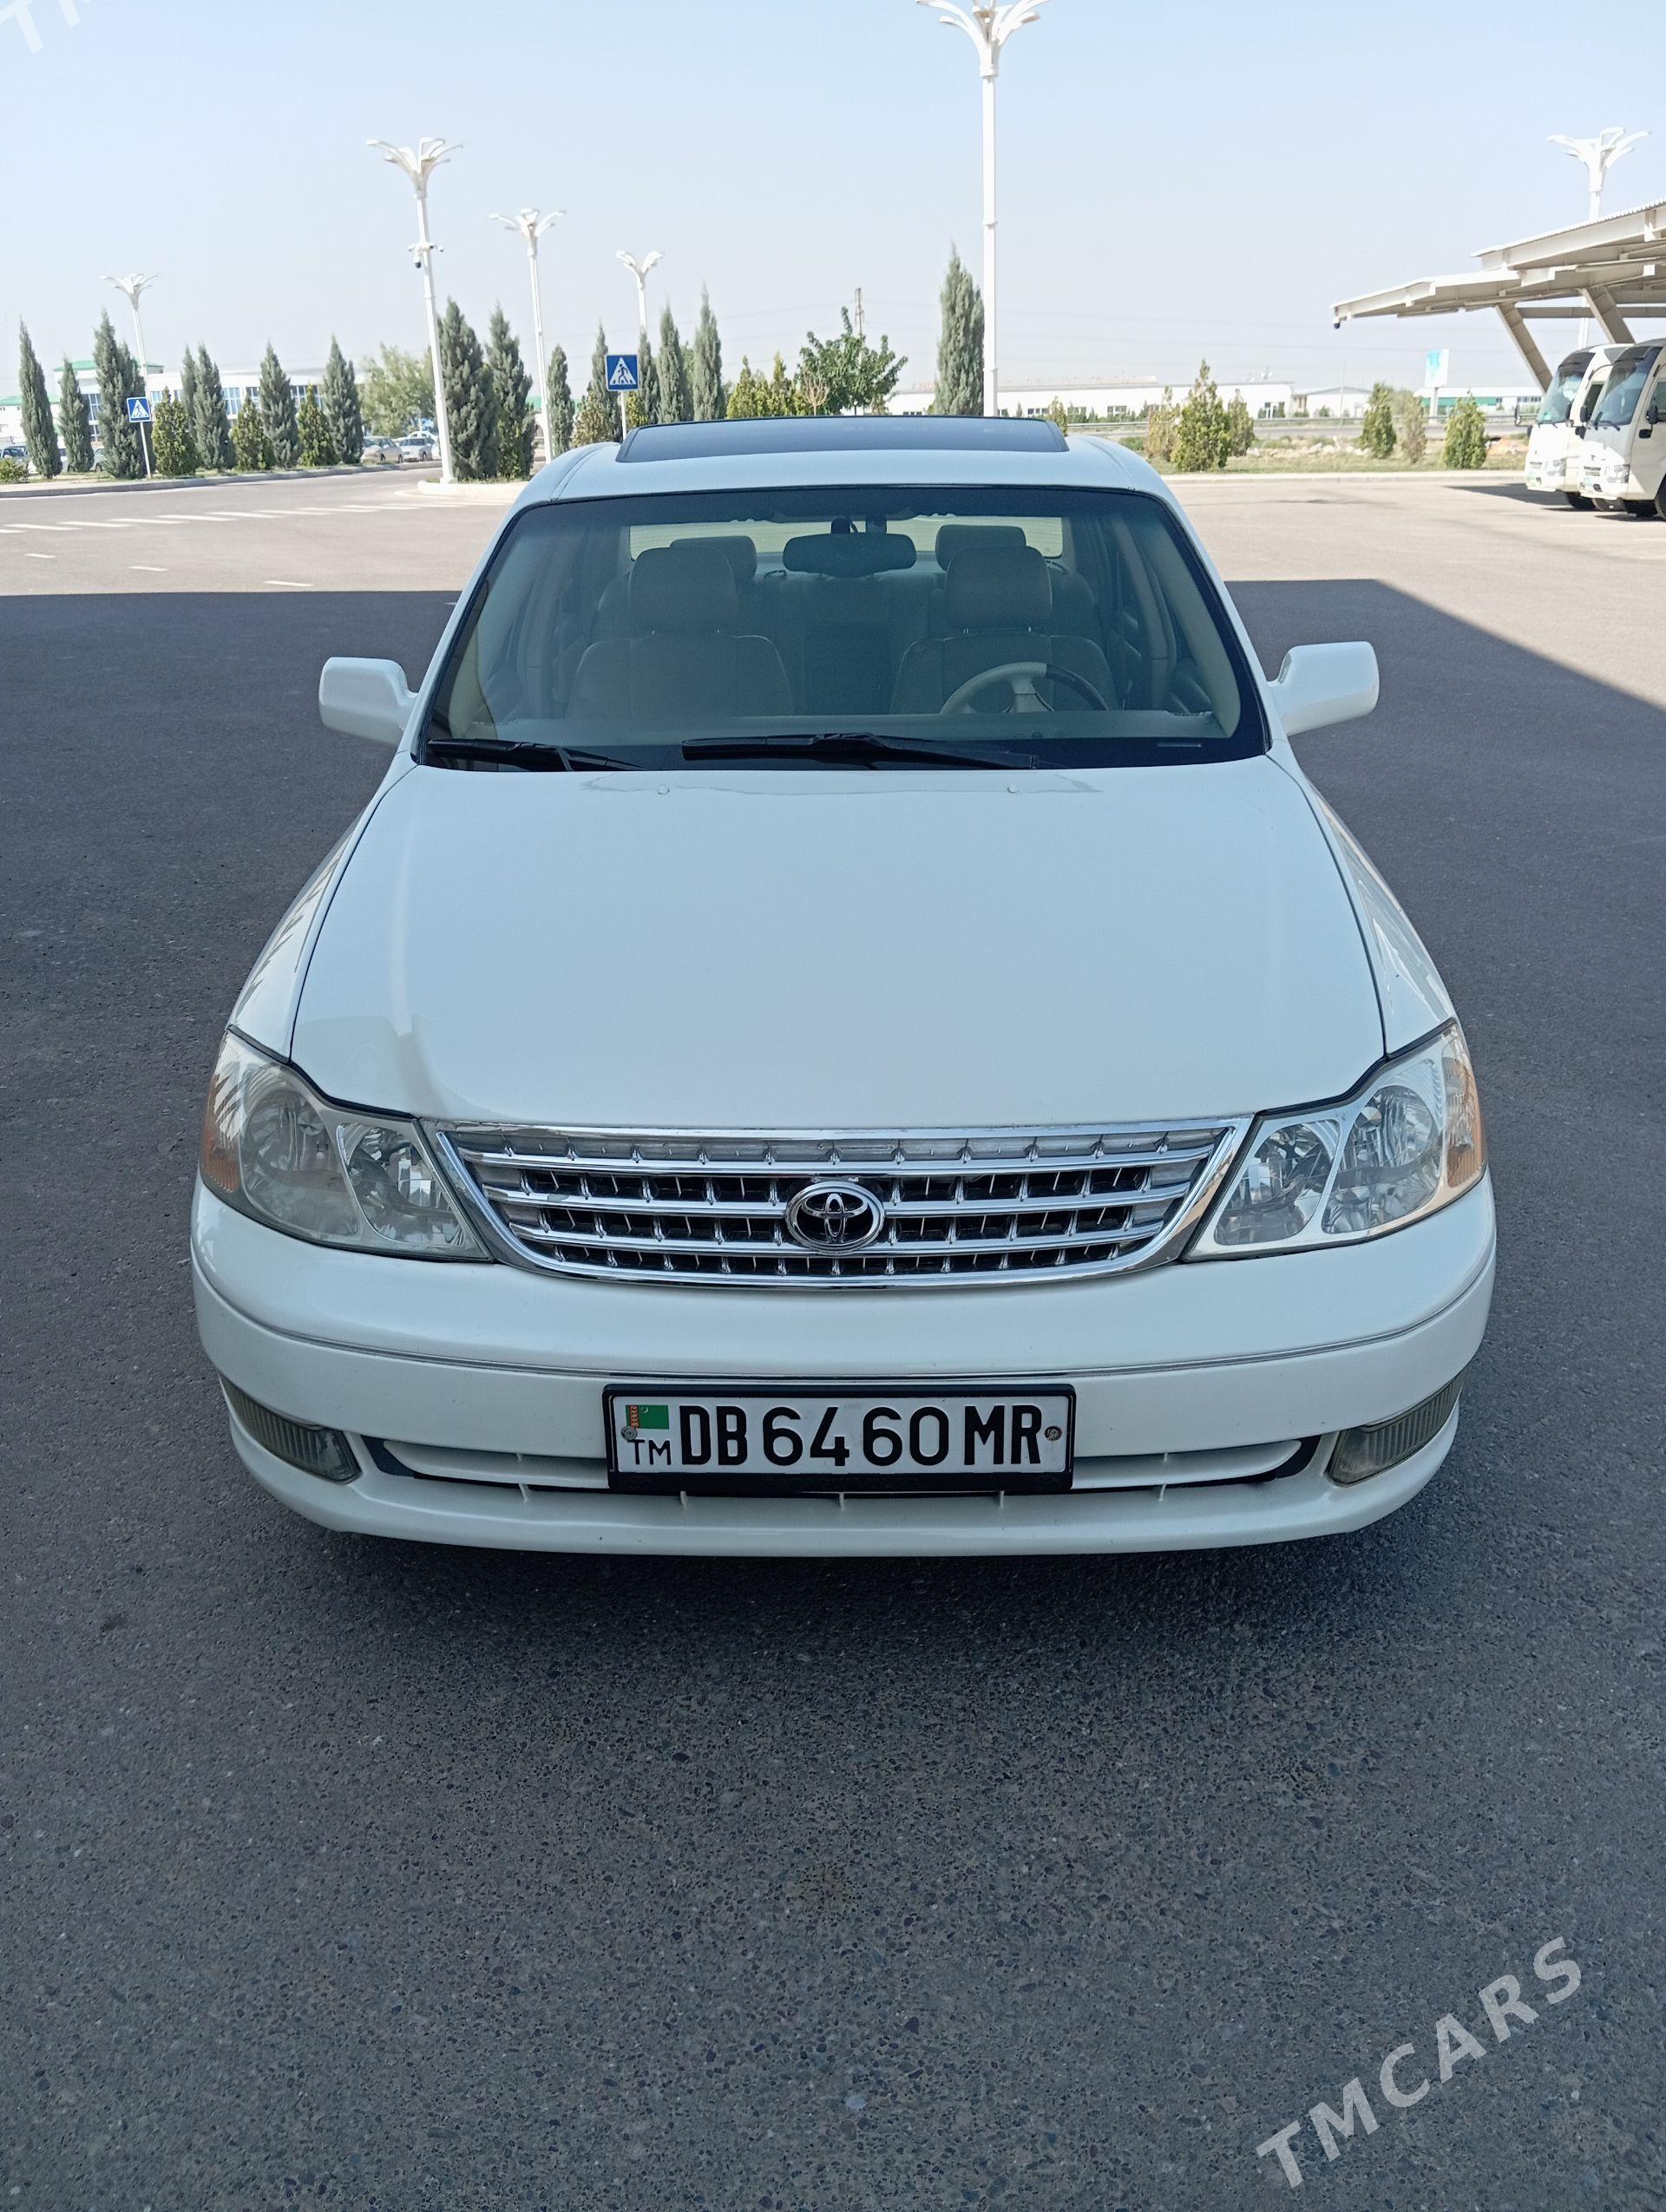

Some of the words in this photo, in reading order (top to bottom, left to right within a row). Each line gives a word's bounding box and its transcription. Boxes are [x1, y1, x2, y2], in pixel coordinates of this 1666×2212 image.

[633, 1438, 672, 1466] TM
[679, 1405, 748, 1465] DB
[762, 1406, 949, 1467] 6460
[963, 1405, 1042, 1465] MR
